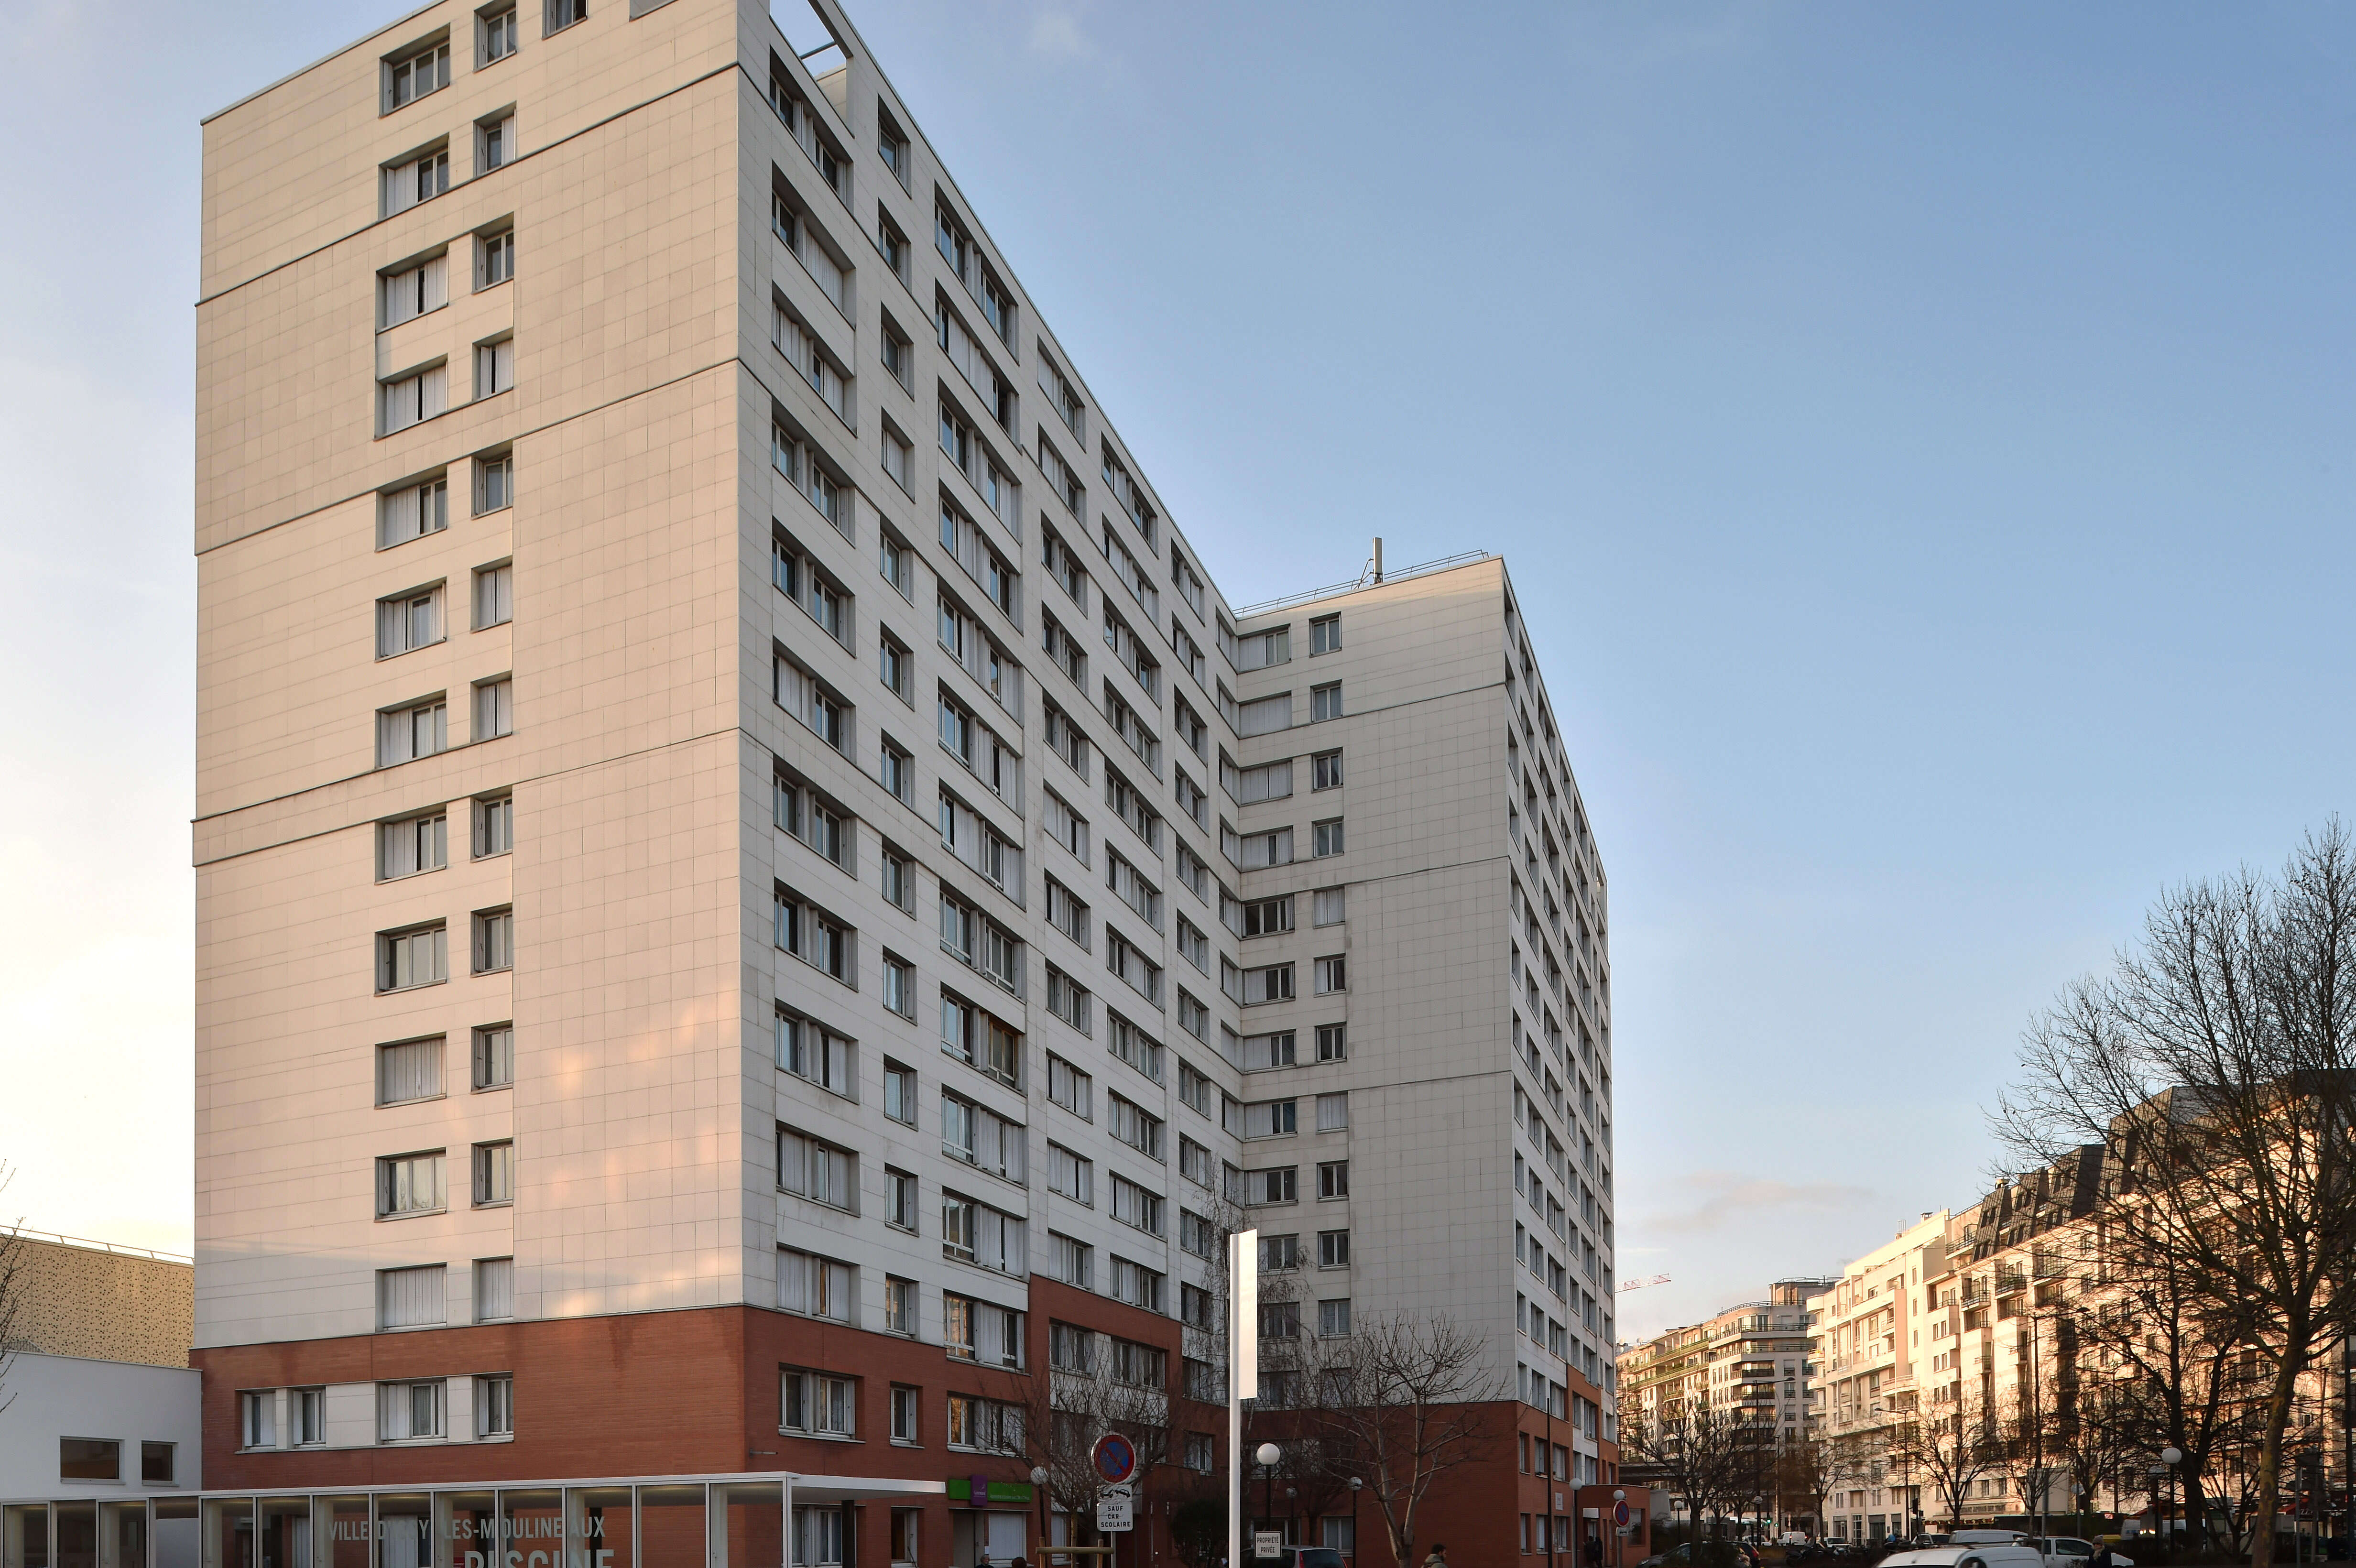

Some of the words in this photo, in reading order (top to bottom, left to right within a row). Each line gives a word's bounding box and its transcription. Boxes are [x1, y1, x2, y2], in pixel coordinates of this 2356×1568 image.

[328, 1521, 369, 1541] VILLE
[1256, 1535, 1279, 1544] PROPRIÉTÉ
[1261, 1545, 1276, 1553] PRIVÉE
